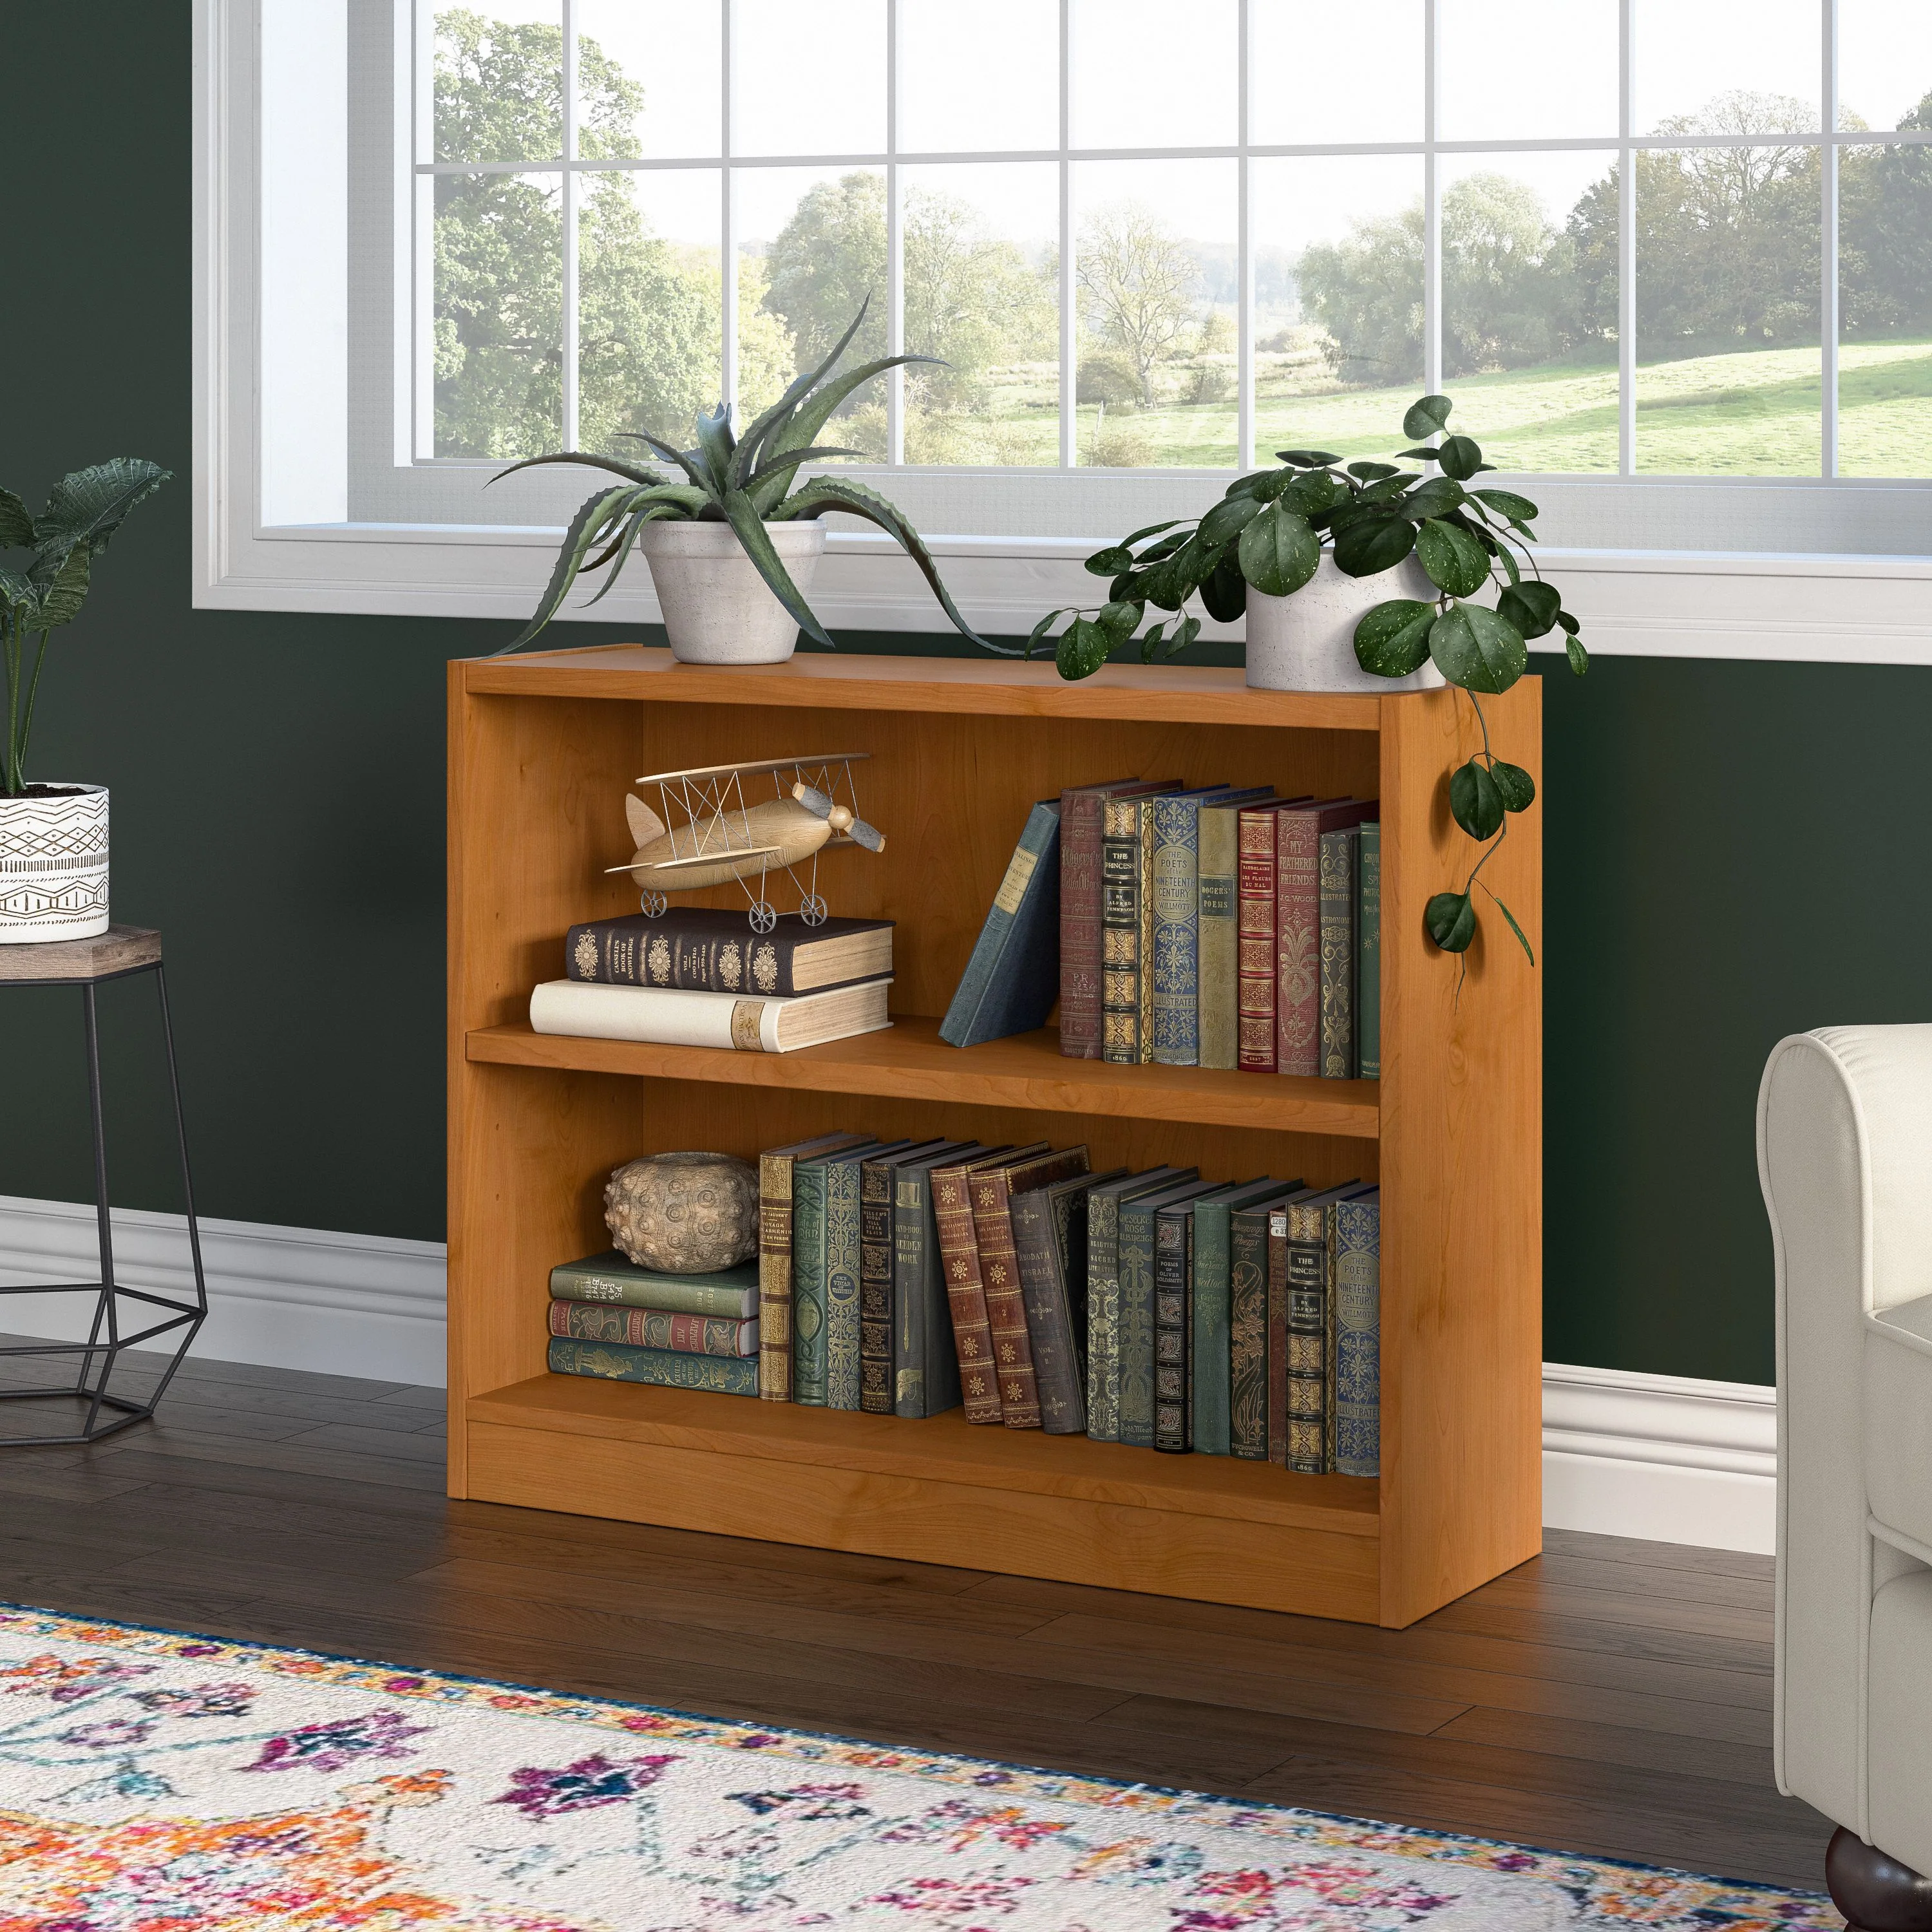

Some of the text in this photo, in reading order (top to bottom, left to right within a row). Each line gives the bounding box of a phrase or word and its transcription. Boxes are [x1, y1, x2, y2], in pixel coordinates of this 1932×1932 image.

[1290, 840, 1302, 854] MY
[1161, 859, 1188, 868] POETS
[1280, 855, 1318, 871] FEATHERED
[1155, 875, 1196, 887] NINETEENTH
[1159, 887, 1191, 898] CENTURY
[1202, 886, 1231, 895] ROGERS'
[1320, 893, 1351, 902] ILLUSTRATE
[1159, 902, 1191, 911] WILLMOTT
[1204, 900, 1228, 909] POEMS
[621, 942, 627, 951] OF
[1071, 972, 1088, 983] PR
[1153, 996, 1197, 1007] ILLUSTRATED
[738, 1004, 748, 1032] VOLUME
[895, 1239, 922, 1251] NEEDLE
[1090, 1240, 1117, 1249] BEAUTIES
[898, 1253, 918, 1264] WORK
[1090, 1255, 1116, 1264] SACRED
[1289, 1266, 1320, 1274] PRINCESS
[1345, 1265, 1372, 1275] POETS
[614, 1286, 623, 1299] PS
[1341, 1294, 1376, 1306] CENTURY
[1341, 1308, 1376, 1319] WILLMOTT
[677, 1327, 685, 1344] ART
